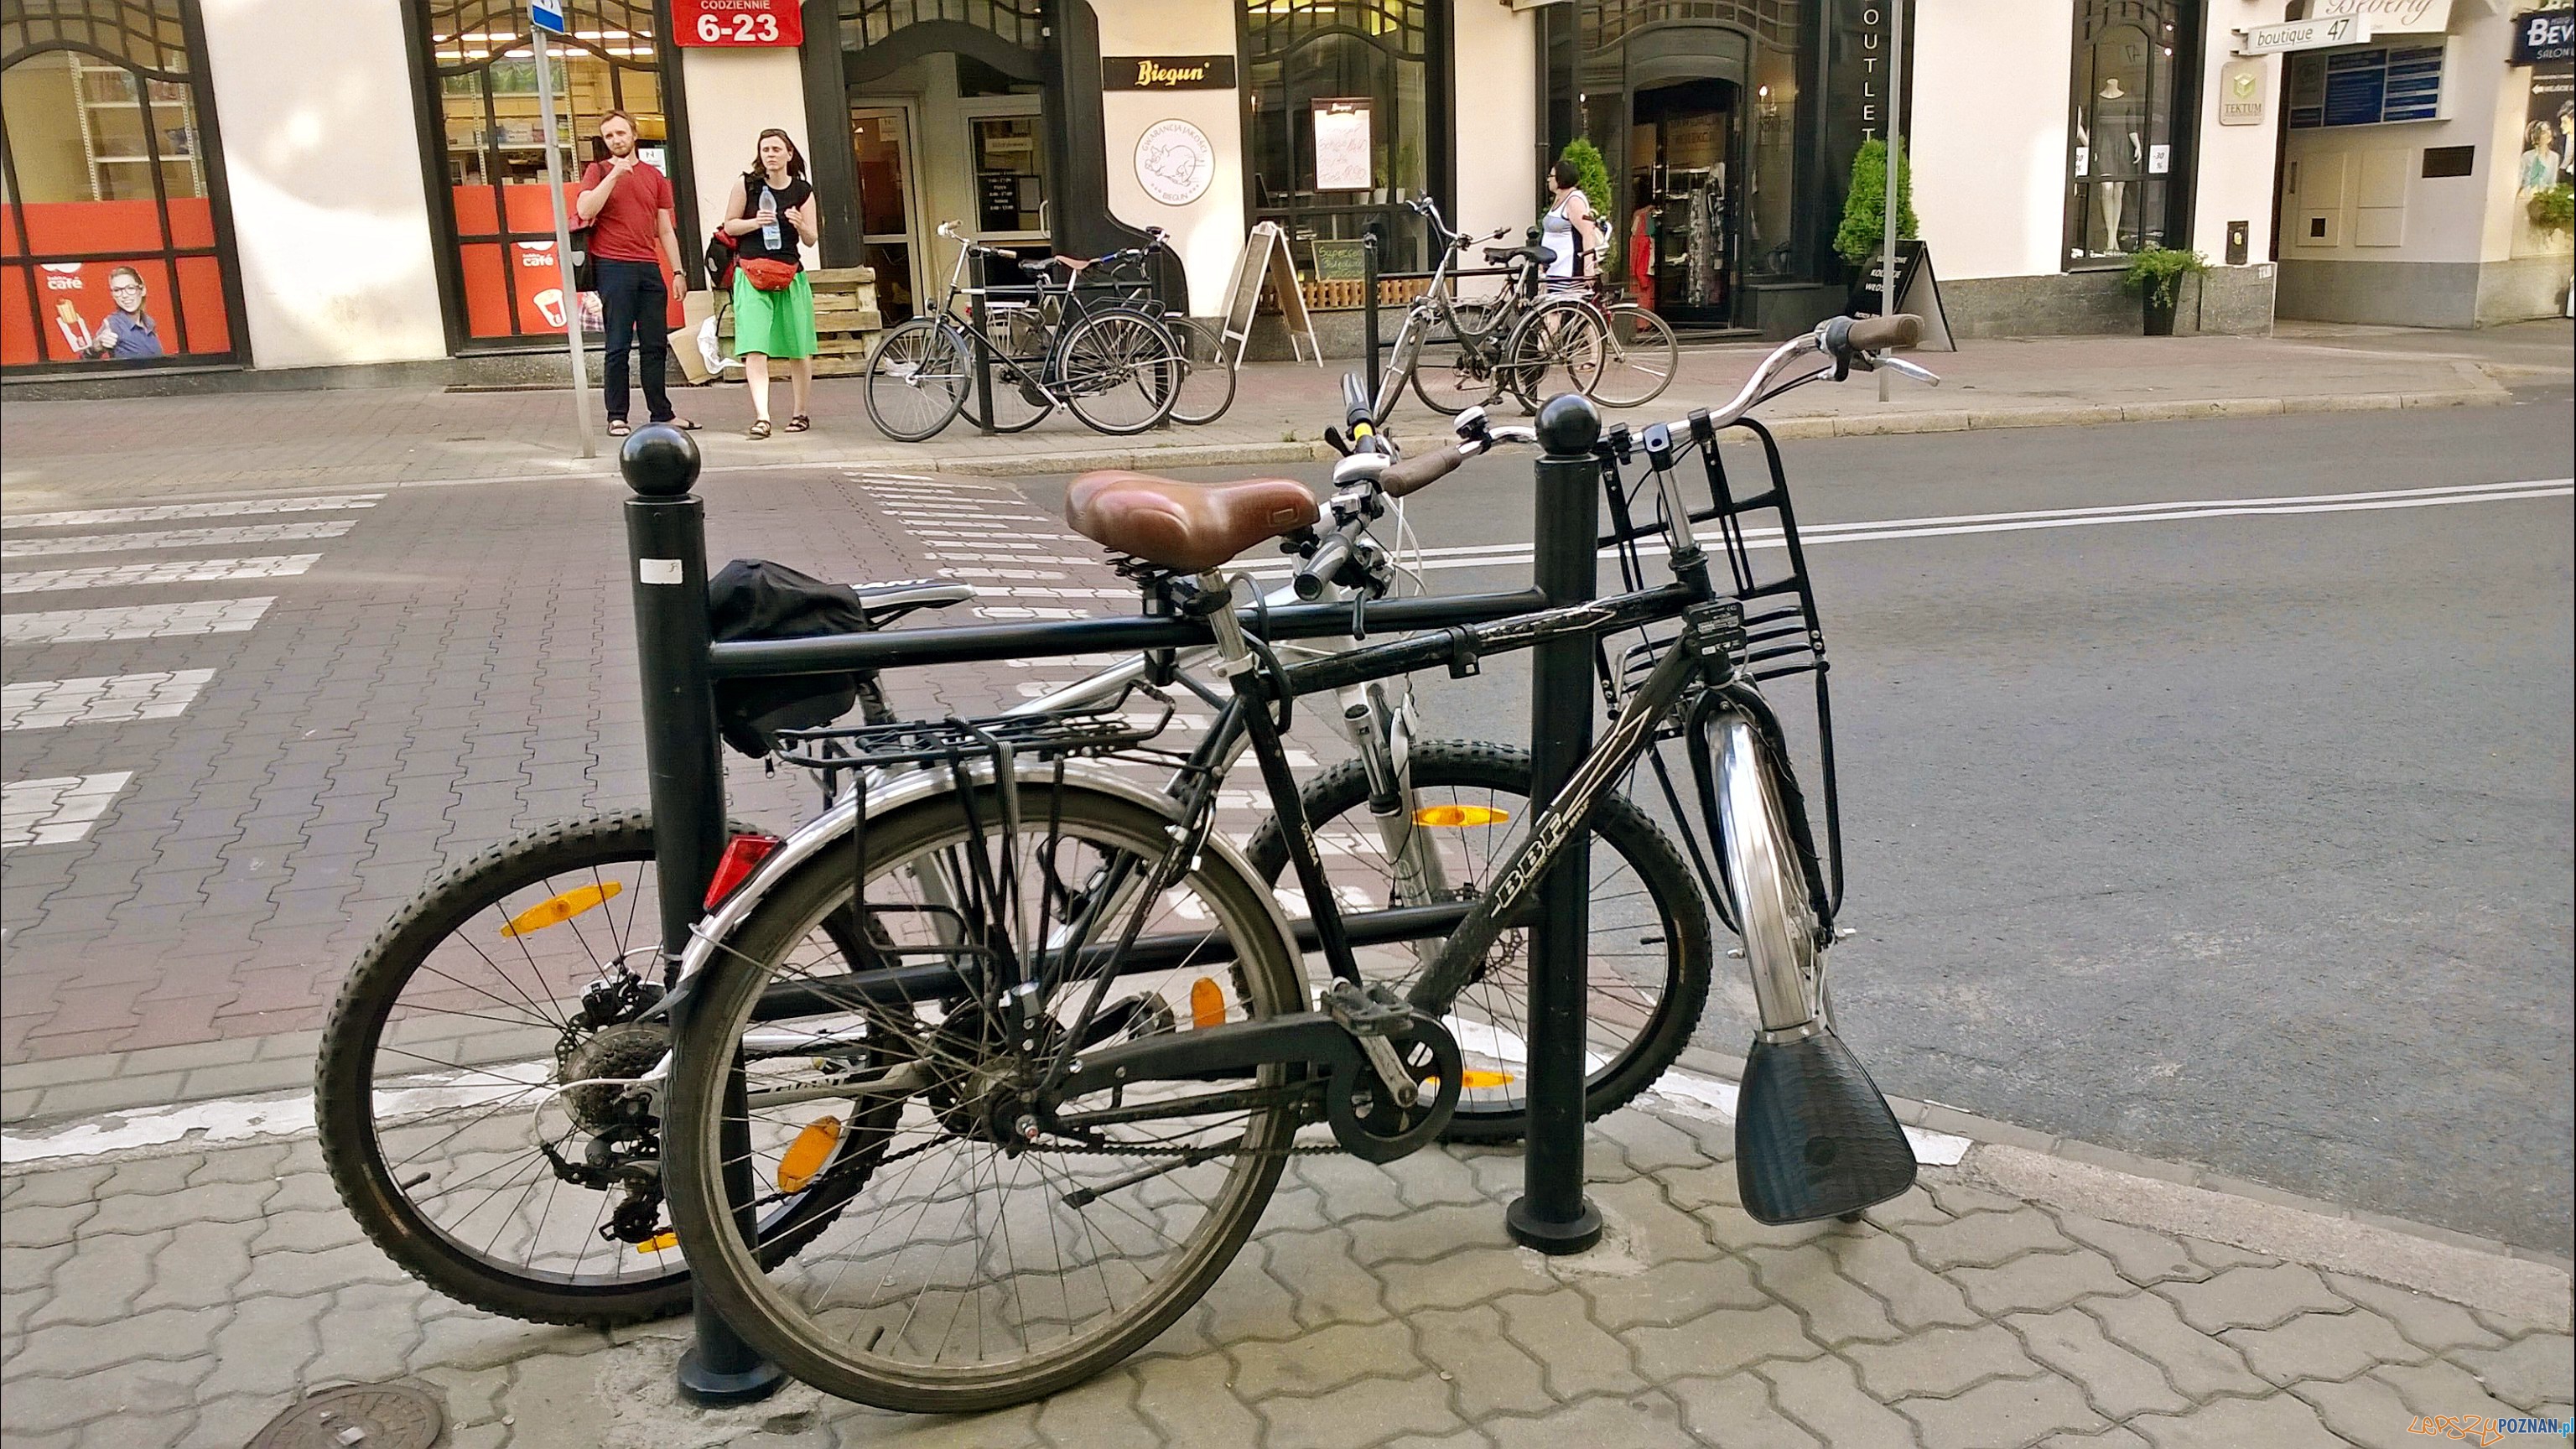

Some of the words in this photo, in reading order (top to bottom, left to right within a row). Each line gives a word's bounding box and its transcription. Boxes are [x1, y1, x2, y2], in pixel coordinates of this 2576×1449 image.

[700, 0, 771, 10] CODZIENNIE
[697, 13, 779, 42] 6-23
[2257, 27, 2313, 47] boutique
[2327, 18, 2350, 40] 47
[2527, 18, 2574, 46] BEV
[1135, 60, 1205, 86] Biegun
[1862, 8, 1879, 143] OUTLET
[2225, 103, 2262, 113] TEKTUM
[1141, 123, 1182, 152] GWARANCJA
[1182, 127, 1208, 153] JAKOŚCI
[1162, 191, 1189, 202] BIEGUN
[522, 253, 554, 267] café
